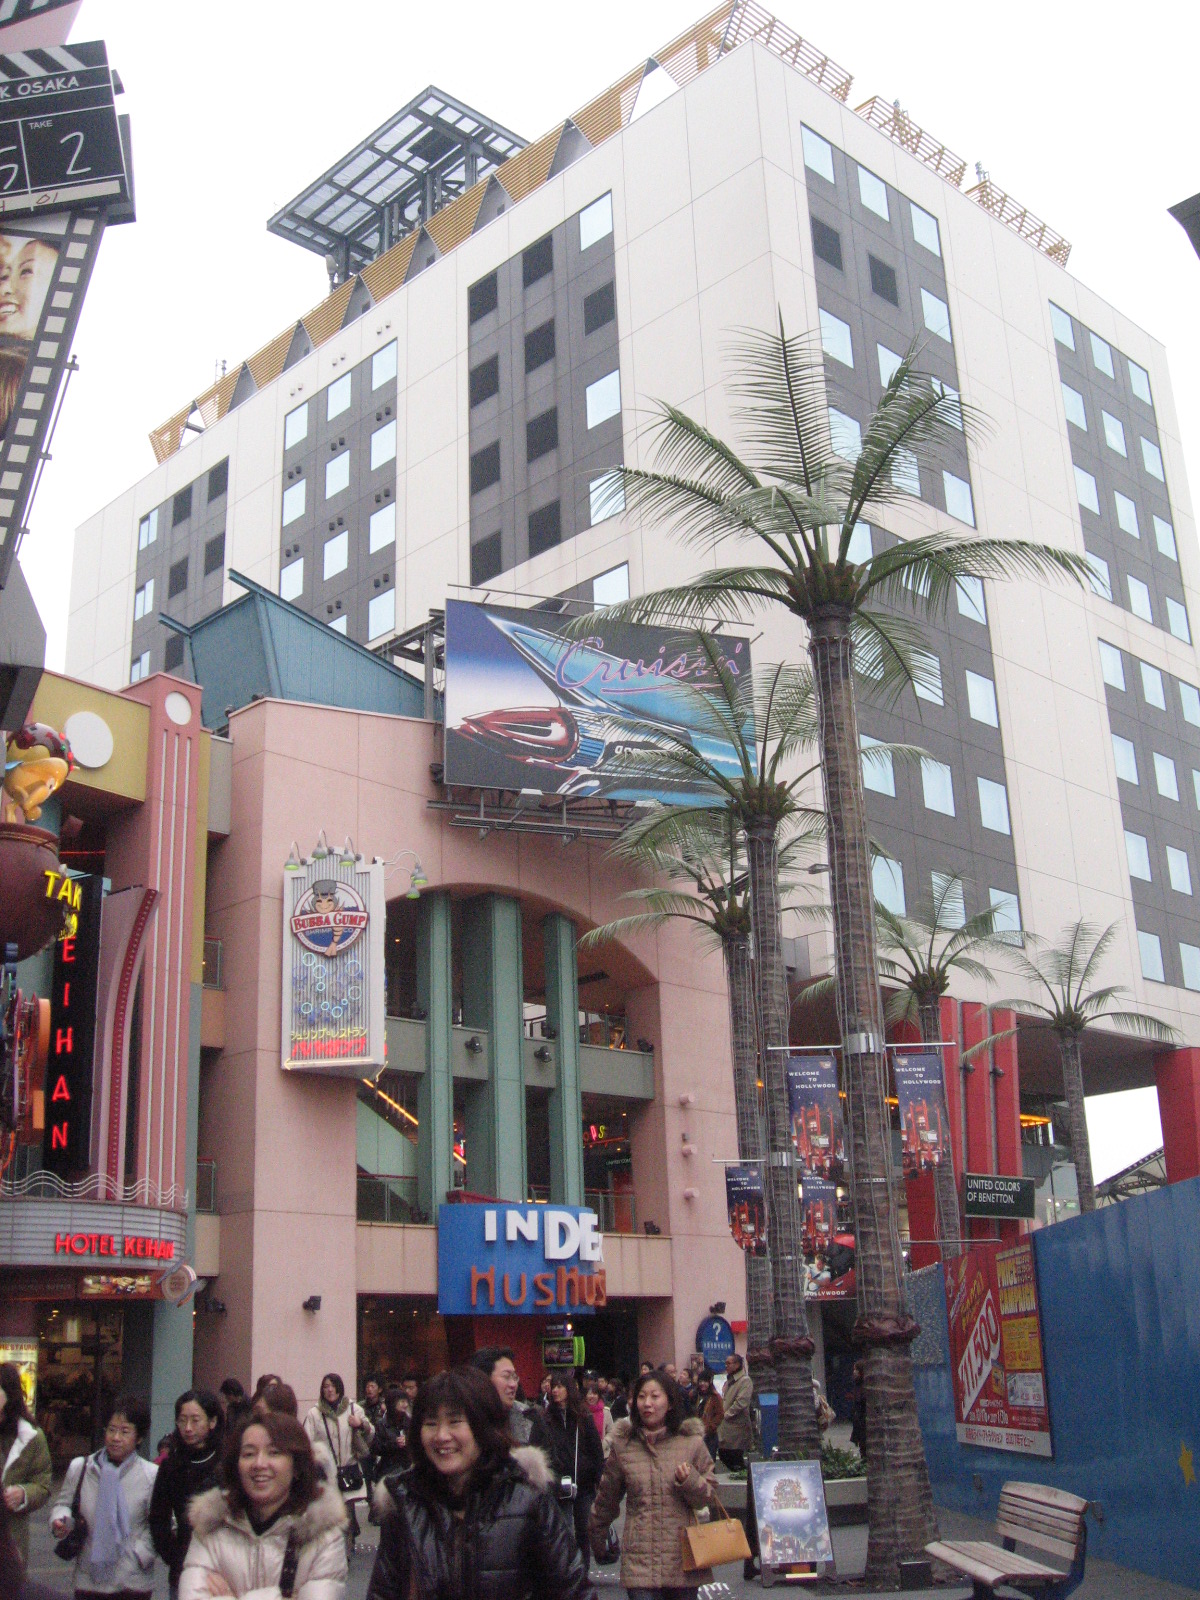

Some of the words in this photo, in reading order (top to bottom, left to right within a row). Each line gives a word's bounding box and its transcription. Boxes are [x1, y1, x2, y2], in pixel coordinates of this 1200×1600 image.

[17, 76, 80, 97] OSAKA
[28, 120, 53, 130] TAKE
[59, 131, 92, 175] 2
[293, 913, 332, 931] BUBBA
[333, 912, 366, 927] GUMP
[304, 928, 333, 937] SHRIMP
[967, 1179, 993, 1190] UNITED
[994, 1181, 1021, 1192] COLORS
[967, 1192, 977, 1202] OF
[55, 1233, 118, 1256] HOTEL
[124, 1236, 175, 1260] KEIHAN
